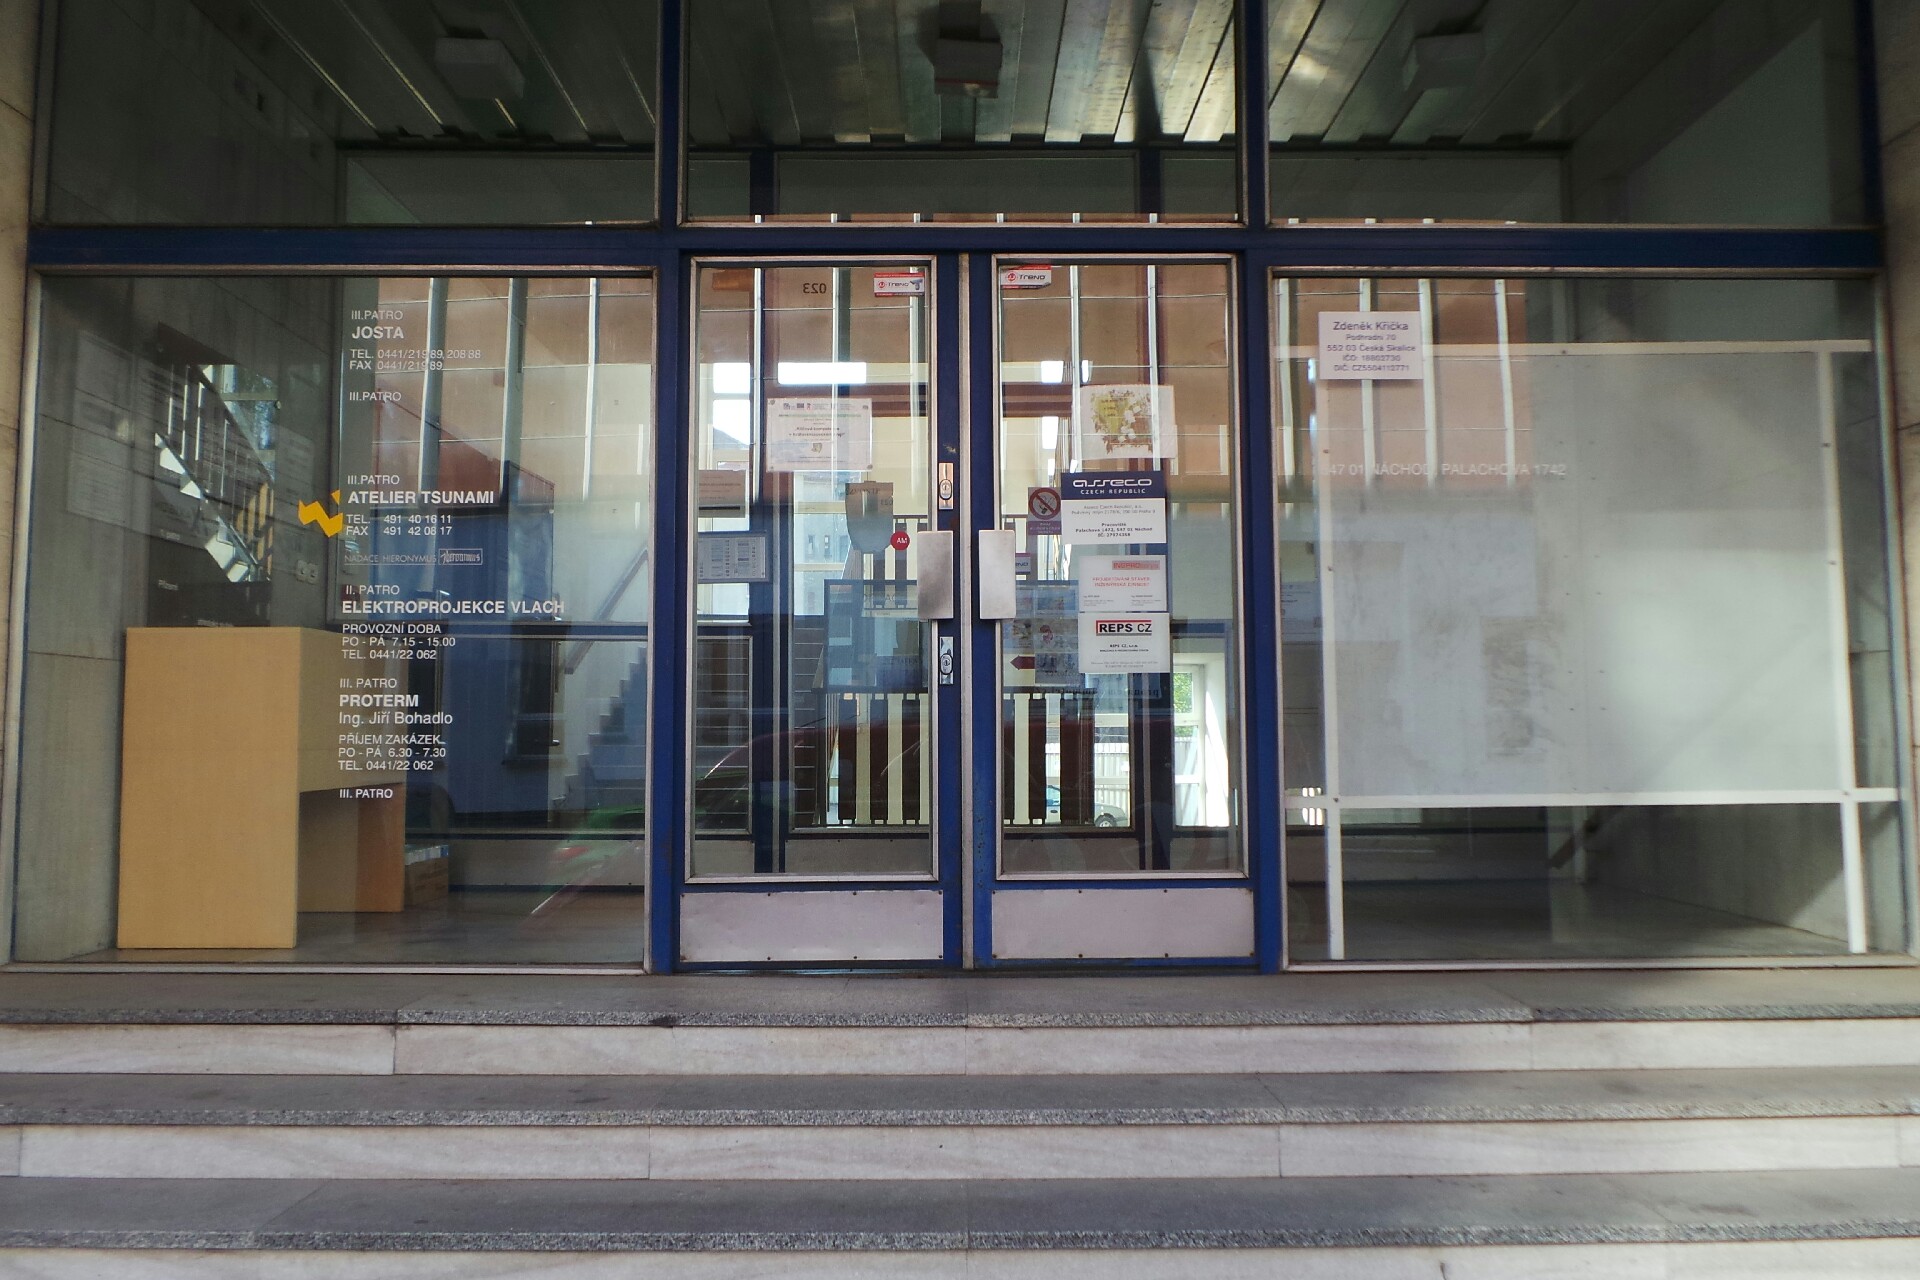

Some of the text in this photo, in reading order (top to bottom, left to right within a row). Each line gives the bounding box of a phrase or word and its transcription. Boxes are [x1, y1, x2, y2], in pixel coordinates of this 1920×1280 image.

[351, 310, 404, 320] III.PATRO
[1332, 321, 1409, 330] Zdeněk Křička
[352, 326, 404, 340] JOSTA
[1327, 344, 1344, 352] 552
[1359, 342, 1384, 352] Česká
[1386, 344, 1416, 352] Skalice
[350, 348, 374, 359] TEL.
[350, 360, 372, 370] FAX
[350, 392, 402, 401] III.PATRO
[1534, 464, 1566, 476] 1742
[348, 474, 400, 485] III.PATRO
[1072, 478, 1152, 488] asseco
[348, 490, 494, 504] ATELIER TSUNAMI
[346, 514, 452, 524] TEL. 491 40 16 11
[346, 526, 452, 536] FAX 491 42 08 17
[344, 554, 379, 563] NADACE
[382, 554, 437, 563] HIERONYMUS
[346, 585, 400, 595] II. PATRO
[342, 600, 565, 614] ELEKTROPROJEKCE VLACH
[342, 622, 442, 634] PROVOZNÍ DOBA
[1100, 623, 1152, 633] REPS CZ
[342, 636, 358, 646] PO
[369, 634, 386, 646] PÁ
[392, 636, 416, 646] 7.15
[427, 636, 456, 646] 15.00
[342, 650, 437, 660] TEL. 0441/22 062
[340, 678, 398, 689] III. PATRO
[339, 694, 419, 707] PROTERM
[339, 711, 453, 728] Ing. Jiří Bohadlo
[338, 732, 382, 745] PŘÍJEM
[338, 748, 356, 758] PO
[366, 745, 382, 758] PÁ
[388, 748, 413, 758] 6.30
[422, 748, 447, 758] 7.30
[338, 760, 434, 771] TEL. 0441/22 062
[340, 788, 394, 798] III. PATRO
